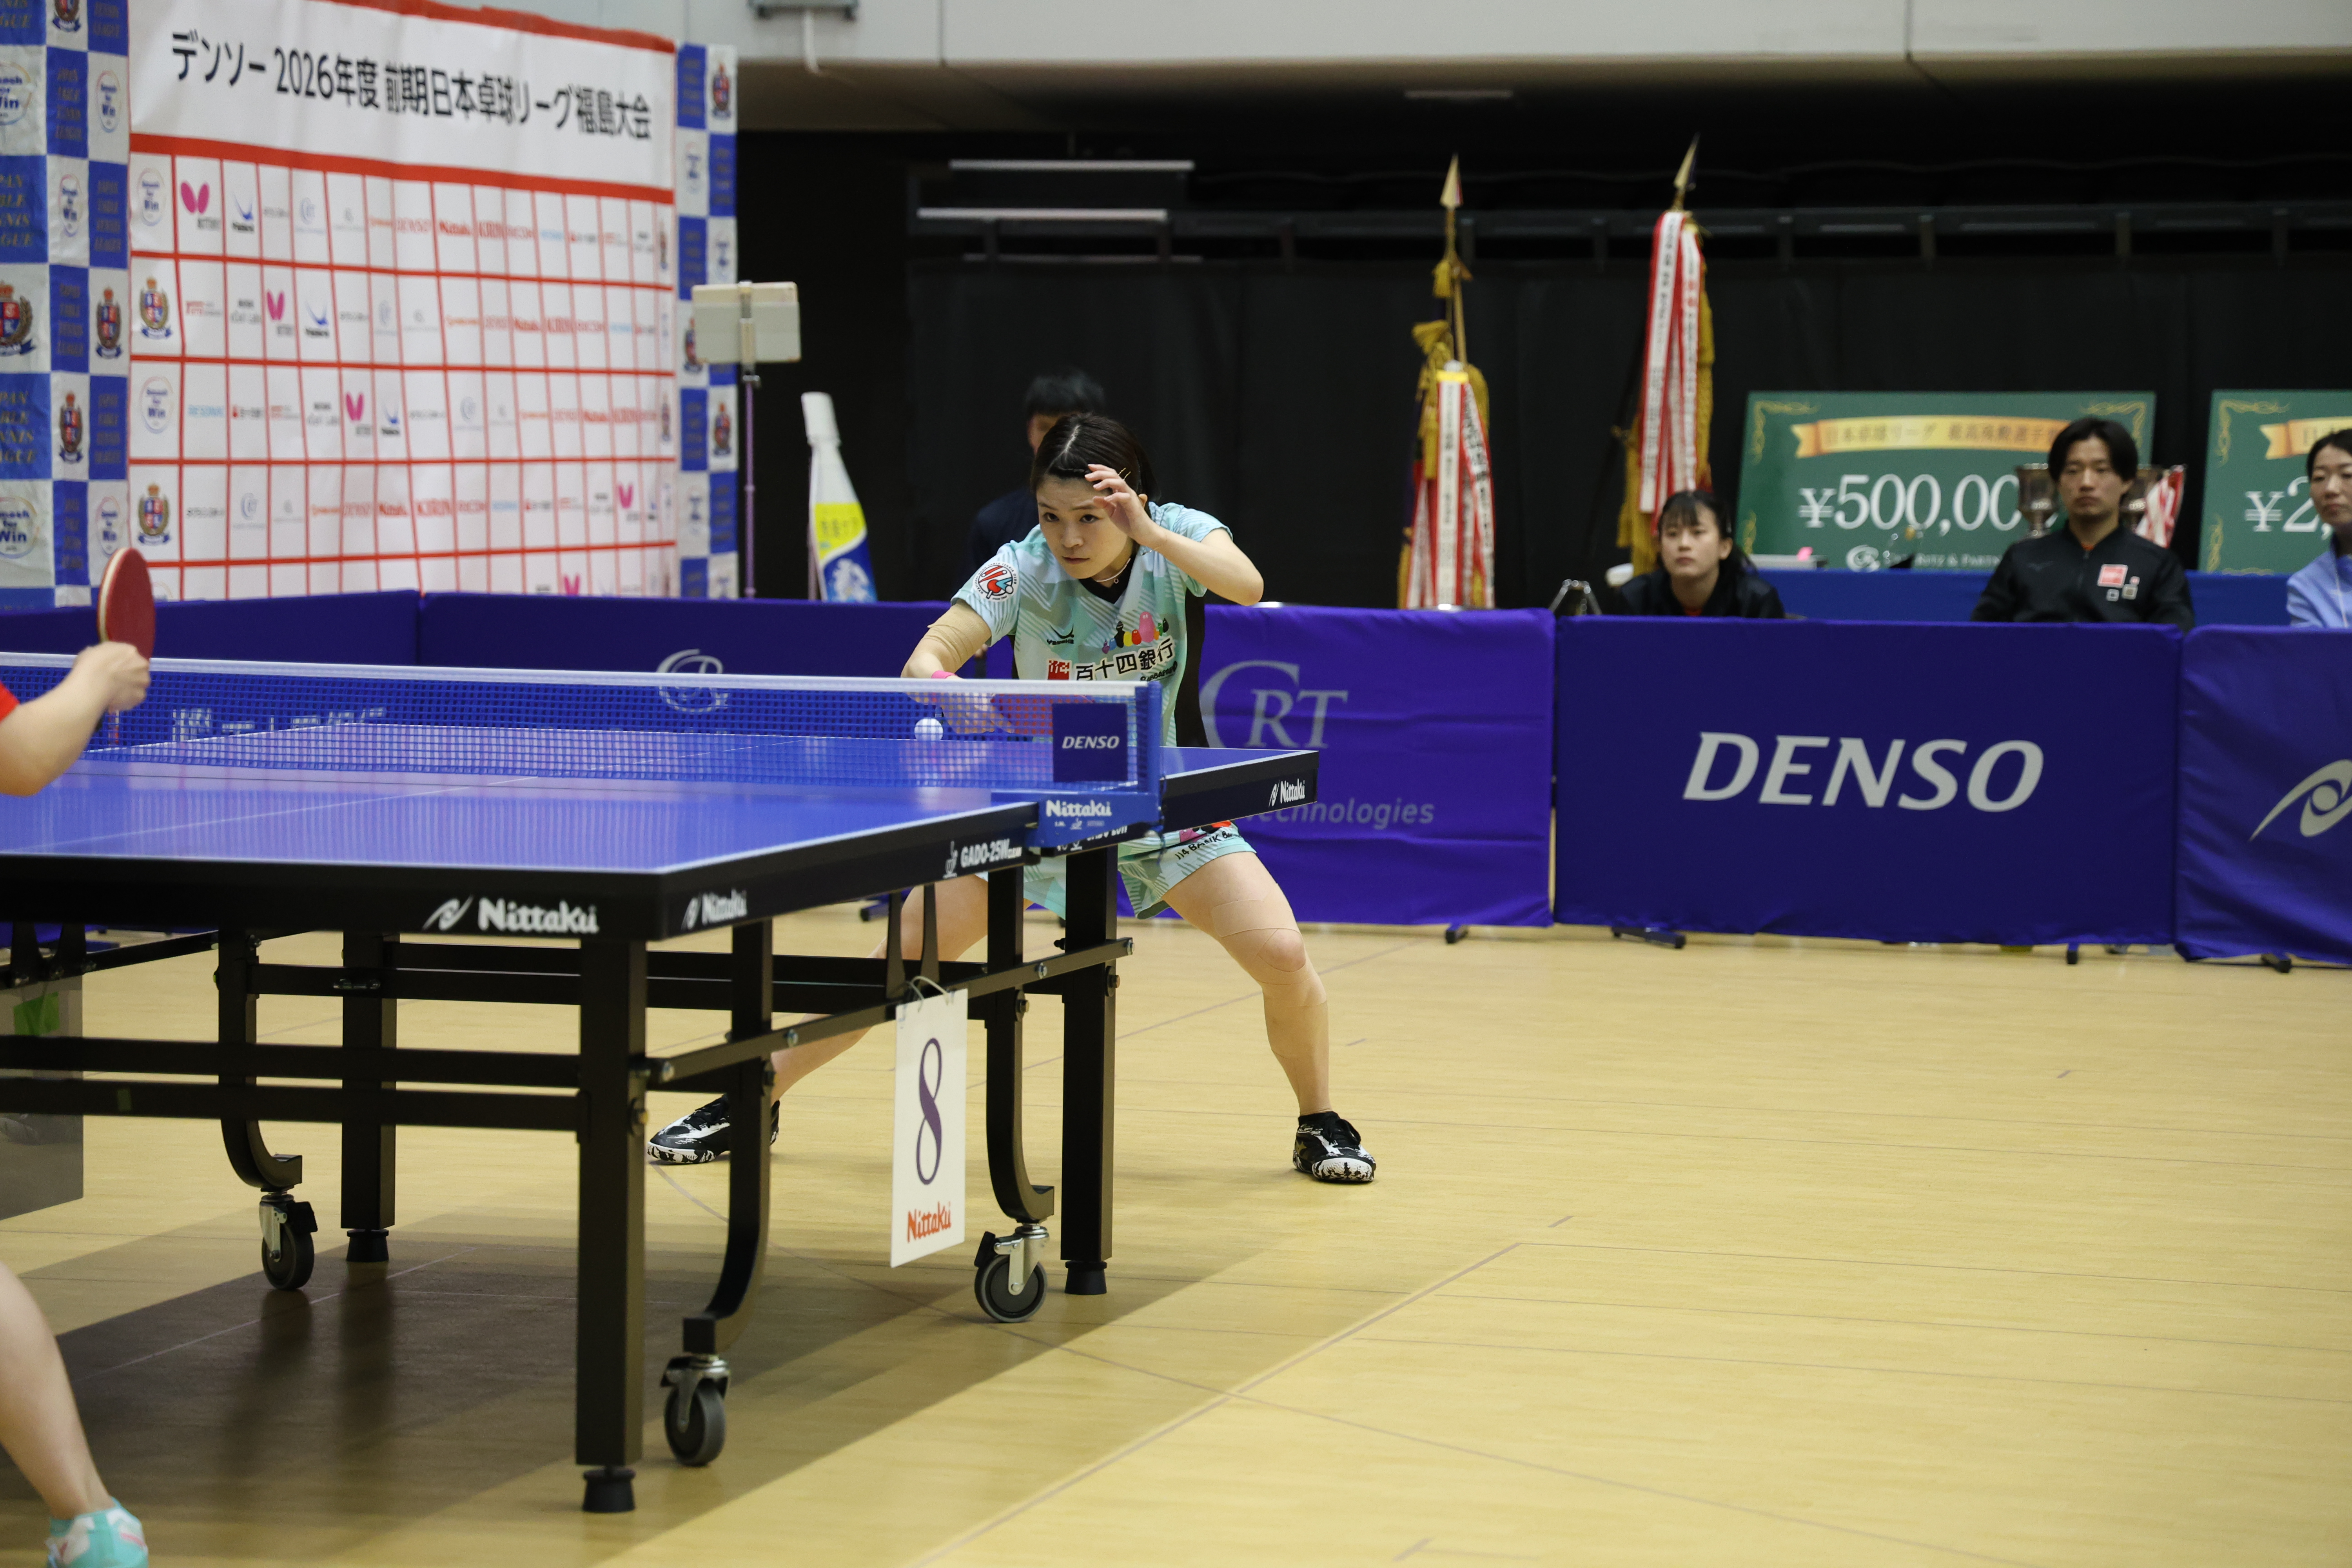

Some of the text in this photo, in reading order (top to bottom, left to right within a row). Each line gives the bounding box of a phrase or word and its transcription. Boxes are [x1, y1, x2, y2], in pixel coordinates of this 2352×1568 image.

[1798, 473, 2022, 537] ¥500,00
[1075, 637, 1173, 681] 百十四銀行
[1062, 735, 1120, 750] DENSO
[1682, 731, 2044, 813] DENSO
[1045, 799, 1112, 817] Nittaku
[1279, 779, 1305, 804] Nittaku
[960, 837, 1011, 868] GADO-25W
[477, 897, 600, 935] Nittaku
[702, 889, 747, 924] Nittaku
[916, 1037, 942, 1185] 8
[907, 1201, 952, 1244] Nittaku
